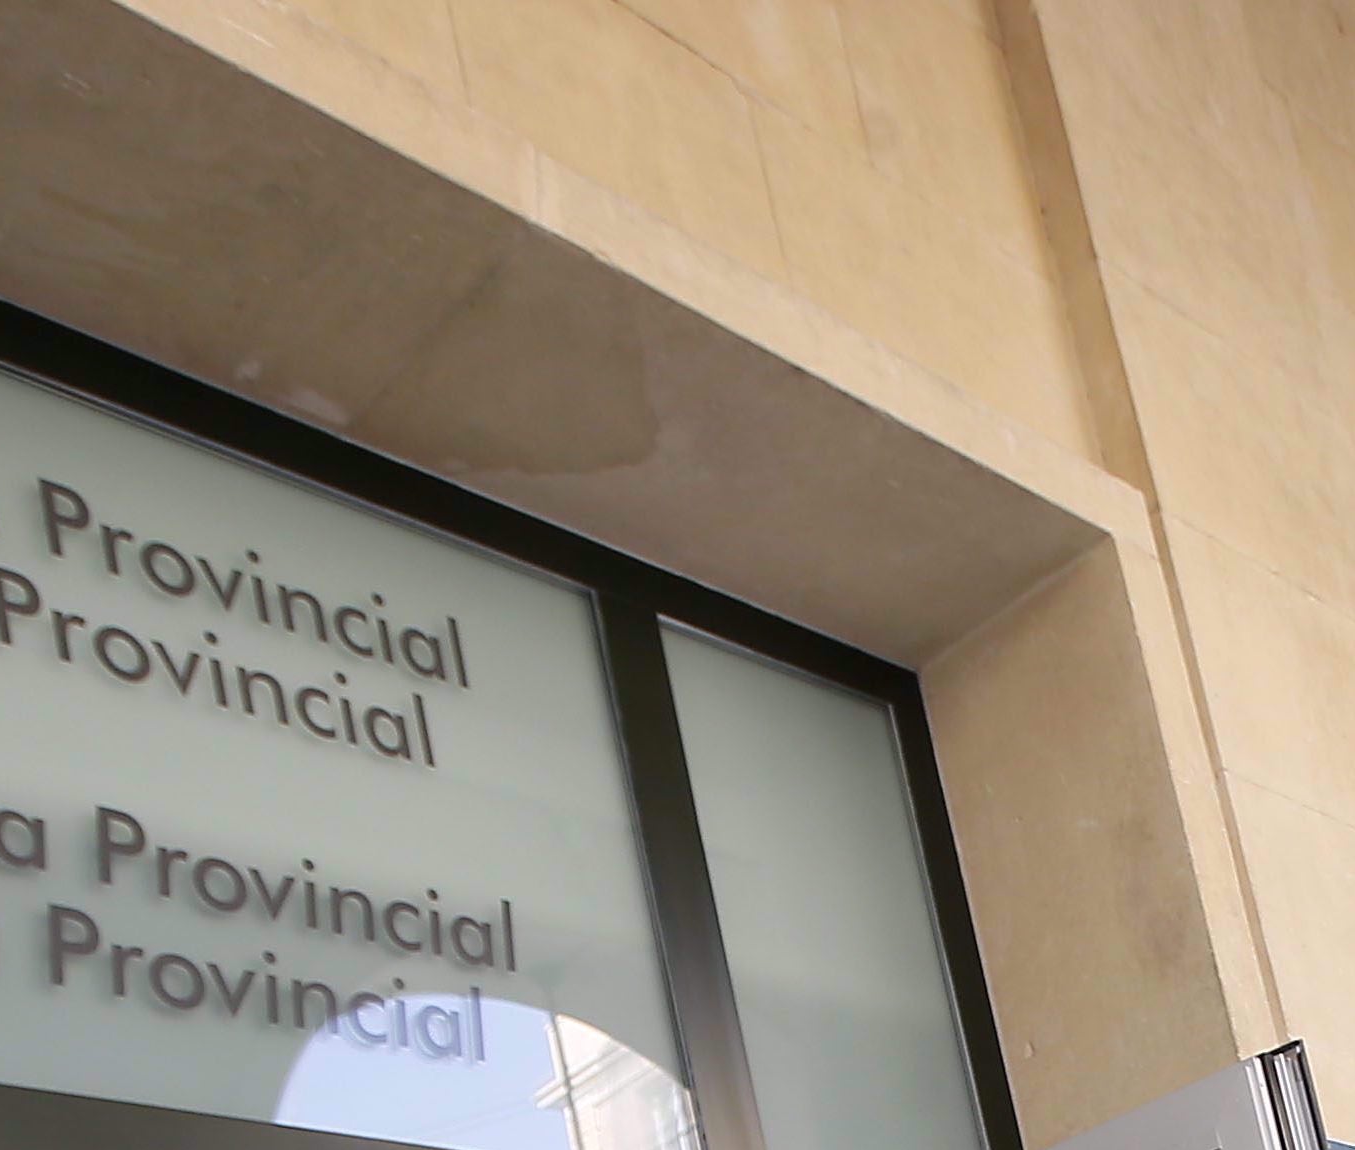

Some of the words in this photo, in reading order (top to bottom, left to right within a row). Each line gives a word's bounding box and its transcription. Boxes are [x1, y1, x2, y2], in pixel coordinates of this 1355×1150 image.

[38, 477, 470, 690] Provincial
[96, 806, 516, 971] Provincial
[48, 904, 485, 1062] Provincial
